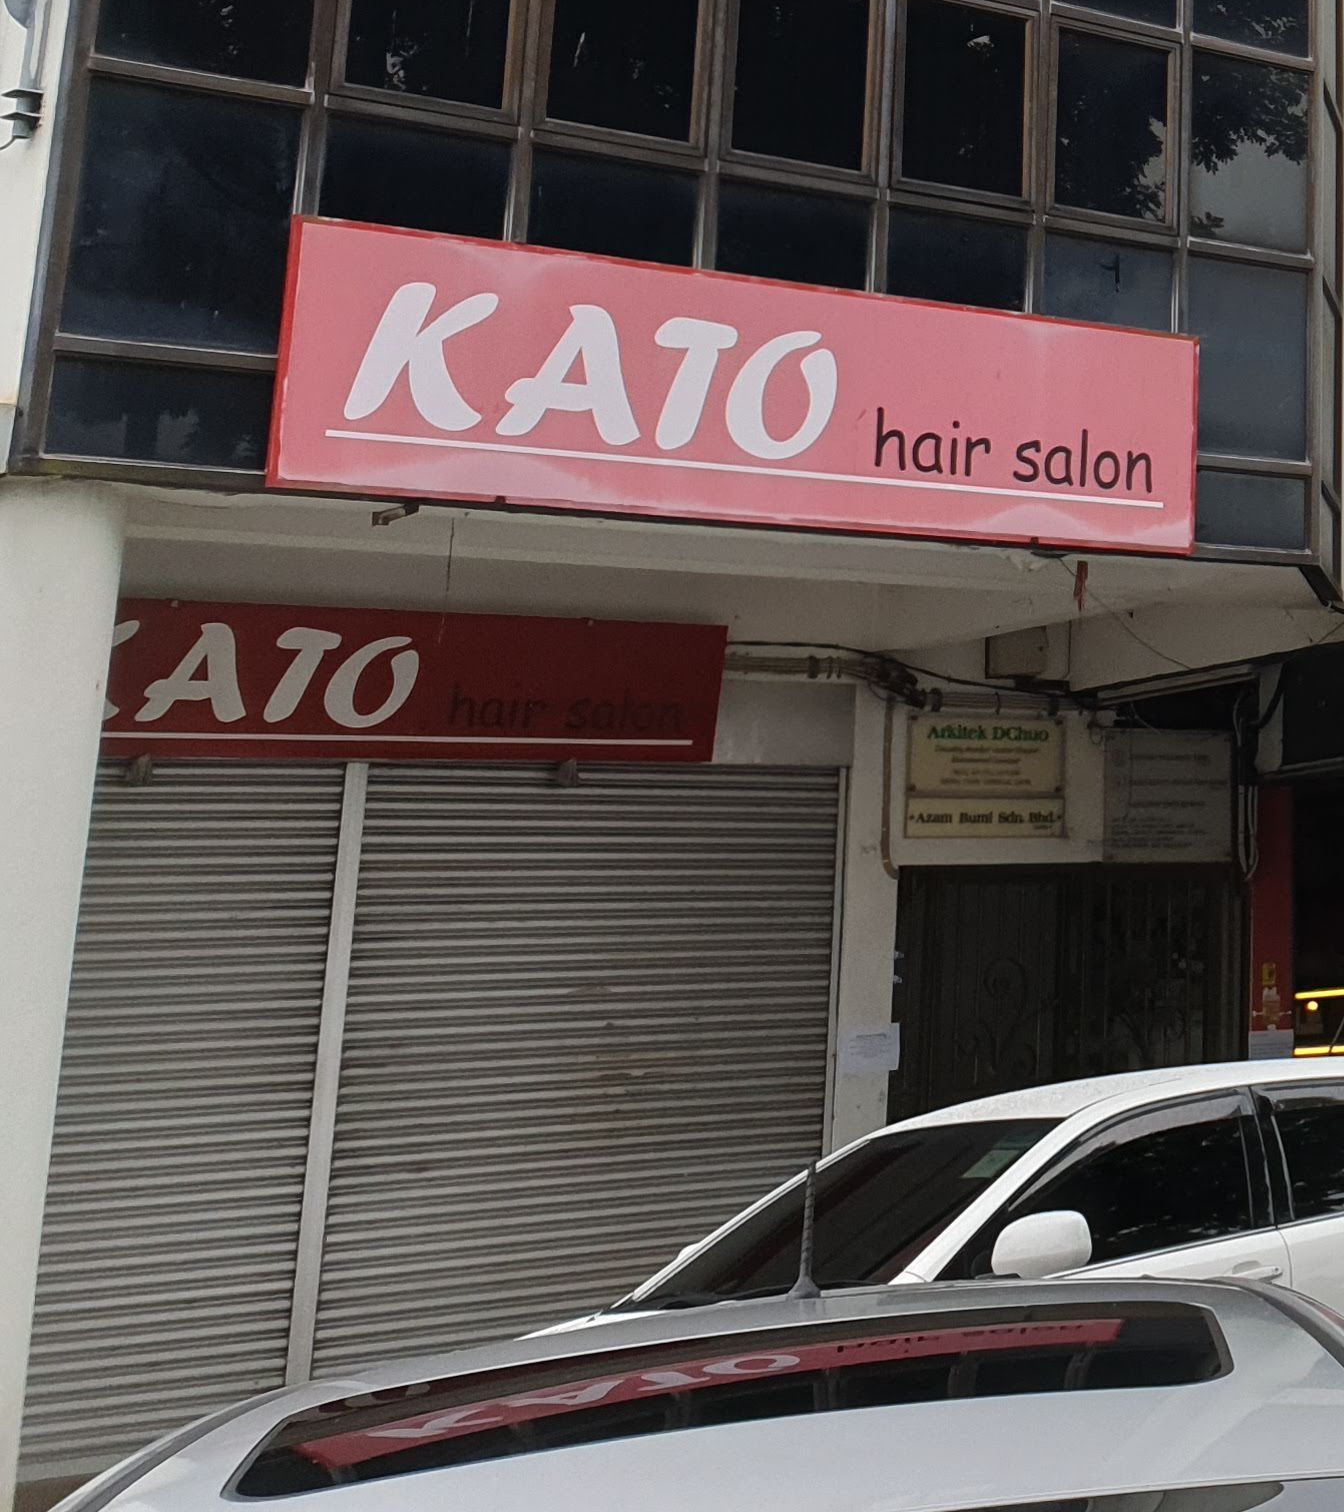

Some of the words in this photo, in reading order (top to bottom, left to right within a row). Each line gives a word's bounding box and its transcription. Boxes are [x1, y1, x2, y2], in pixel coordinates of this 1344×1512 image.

[343, 281, 838, 461] KATO
[873, 405, 992, 479] hair
[1012, 428, 1155, 494] salon
[446, 679, 546, 731] hair
[564, 691, 683, 734] salon
[915, 811, 953, 824] Azam
